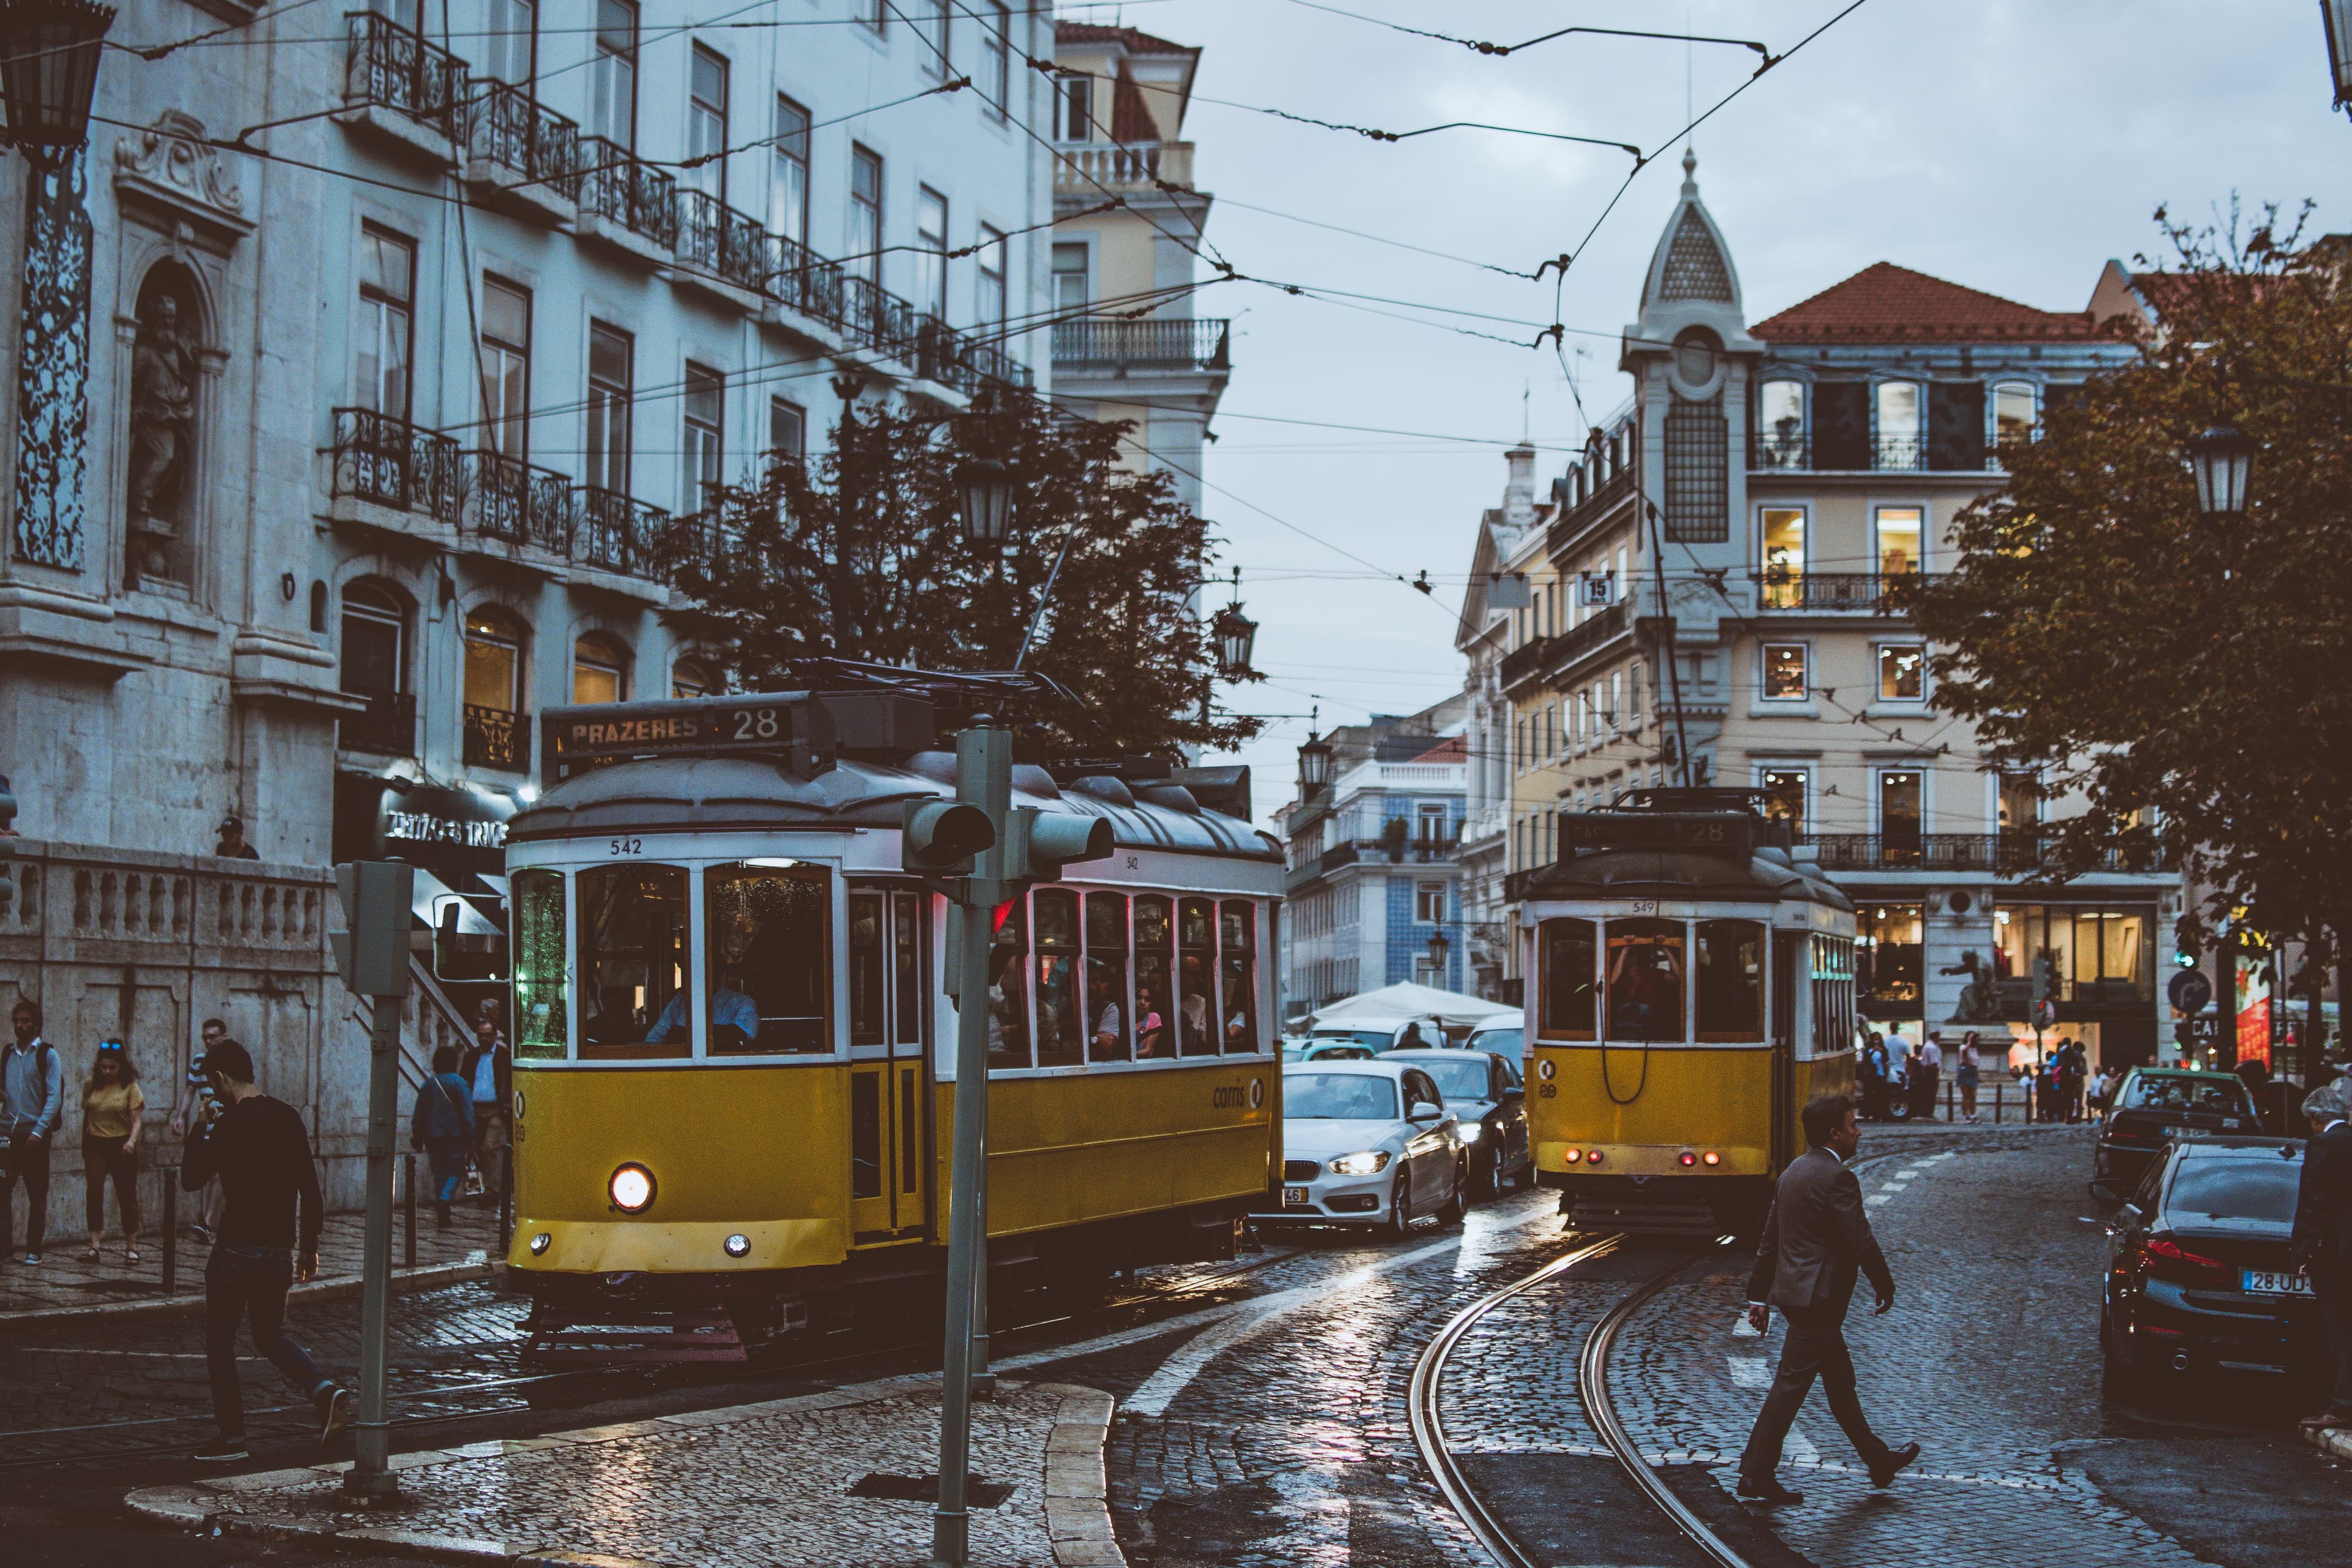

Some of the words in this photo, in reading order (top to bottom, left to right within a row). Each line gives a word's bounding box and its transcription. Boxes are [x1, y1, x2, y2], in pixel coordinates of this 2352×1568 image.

[1589, 581, 1607, 597] 15
[571, 716, 698, 744] PRAZERES
[734, 709, 778, 740] 28
[1691, 823, 1724, 842] 28
[611, 840, 642, 855] 542
[1127, 856, 1138, 870] 542
[1633, 902, 1654, 913] 549
[1213, 1077, 1245, 1109] carris
[1286, 1189, 1300, 1200] 46
